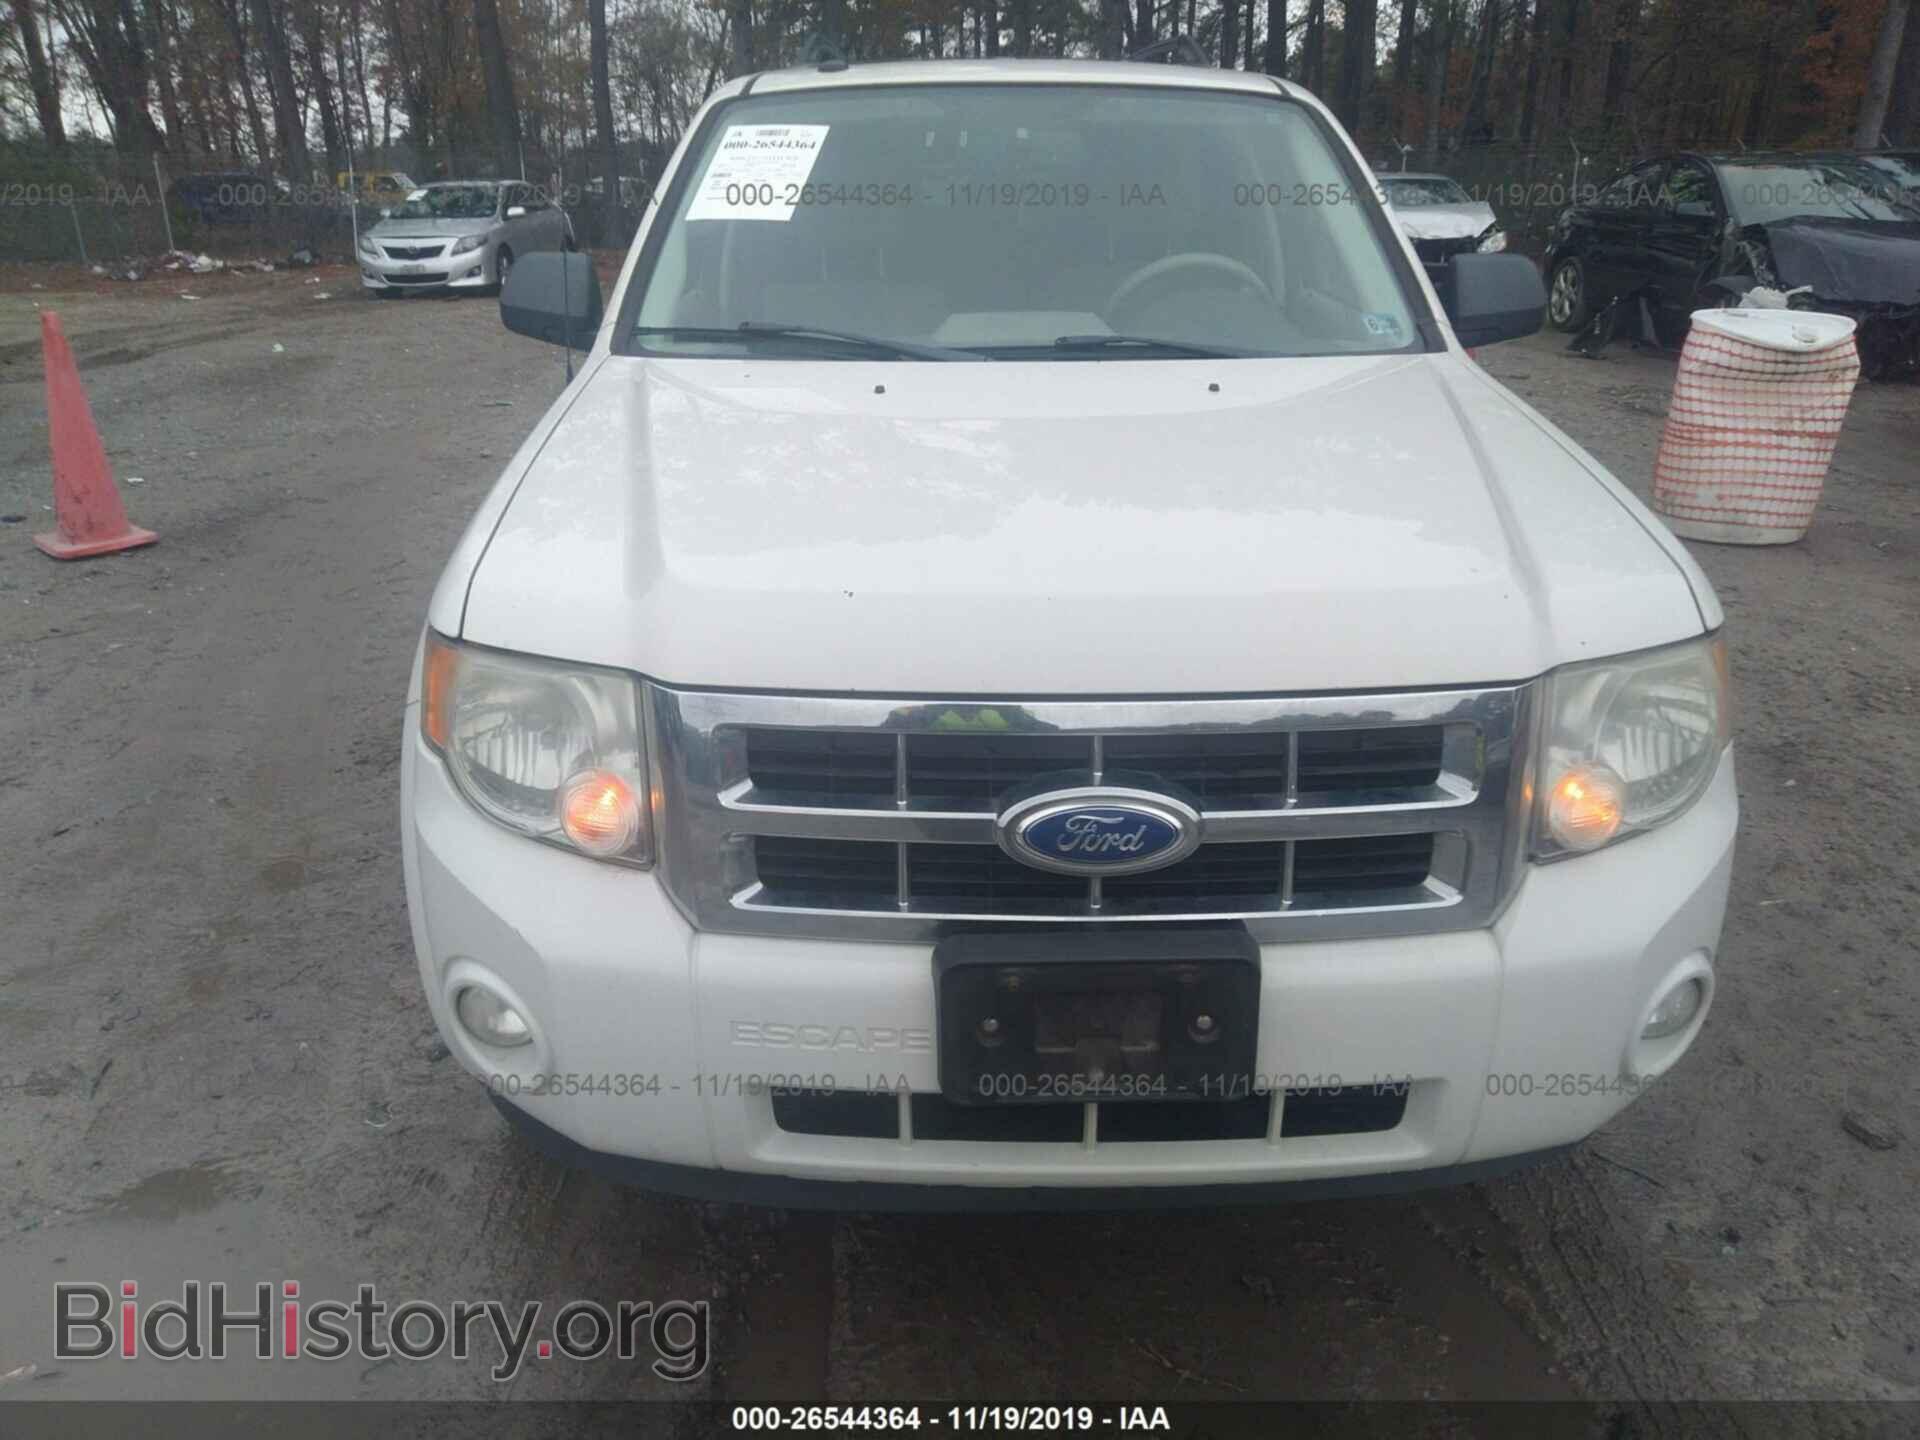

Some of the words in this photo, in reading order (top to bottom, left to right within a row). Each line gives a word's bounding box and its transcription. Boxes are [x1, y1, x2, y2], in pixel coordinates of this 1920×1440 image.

[723, 139, 817, 150] 000-26544364
[1057, 815, 1147, 852] Ford
[730, 1020, 930, 1055] ESCAPE
